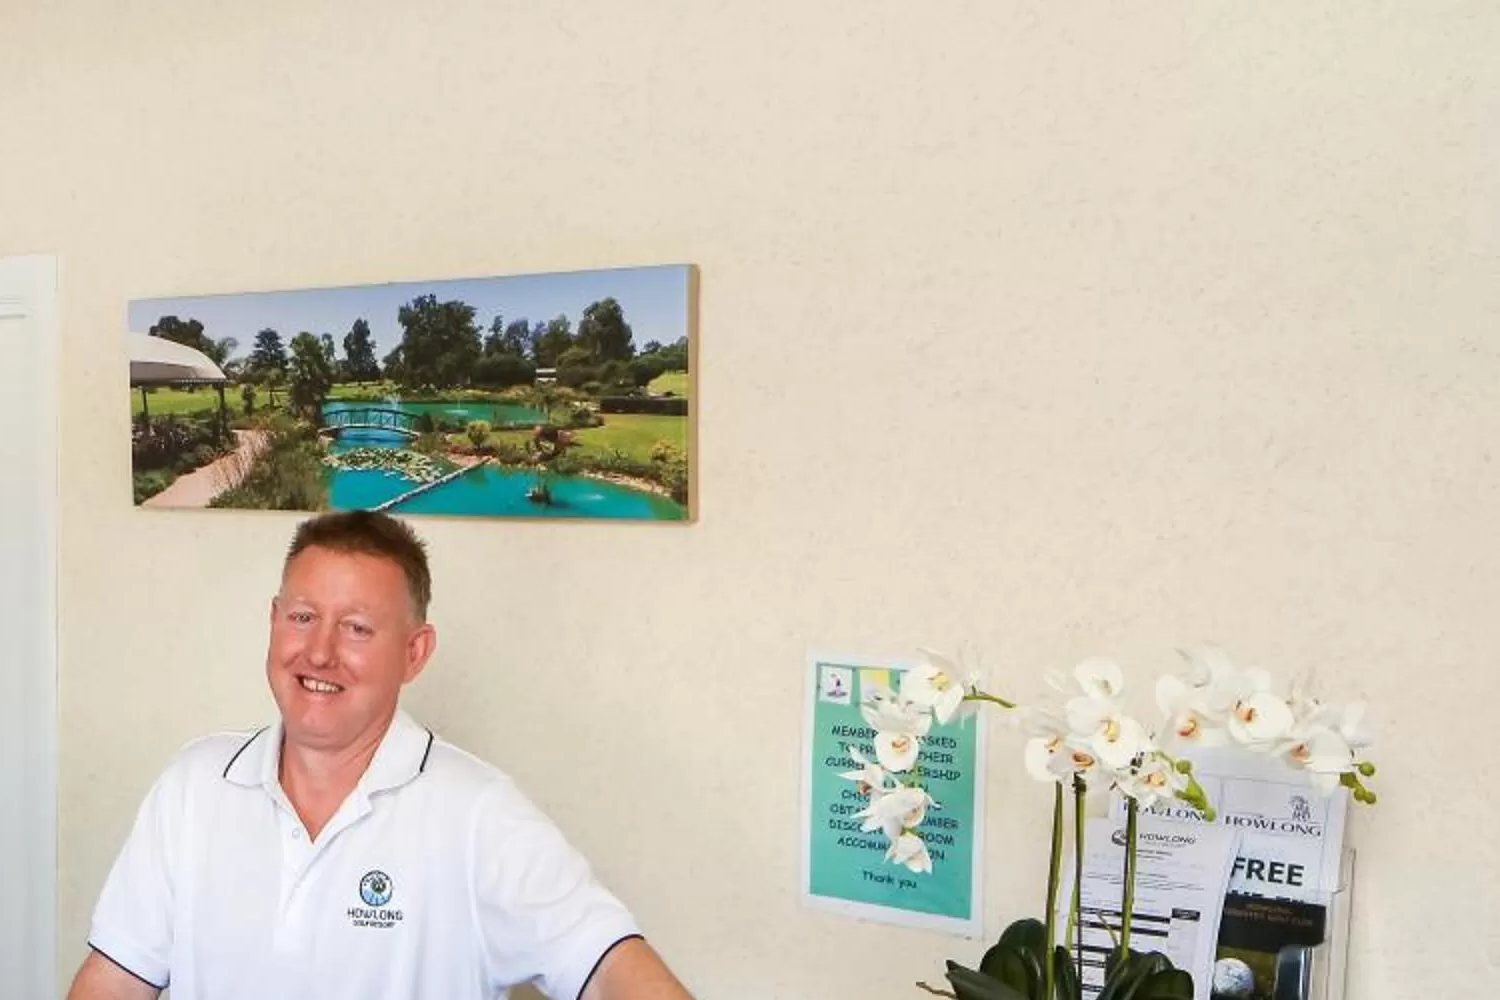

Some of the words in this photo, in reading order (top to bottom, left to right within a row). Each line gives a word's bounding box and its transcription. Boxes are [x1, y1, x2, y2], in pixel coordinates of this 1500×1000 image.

[1225, 815, 1321, 837] HOWLONG
[863, 870, 895, 886] Thank
[898, 879, 918, 890] you
[1230, 855, 1304, 887] FREE
[346, 906, 404, 921] HOWLONG
